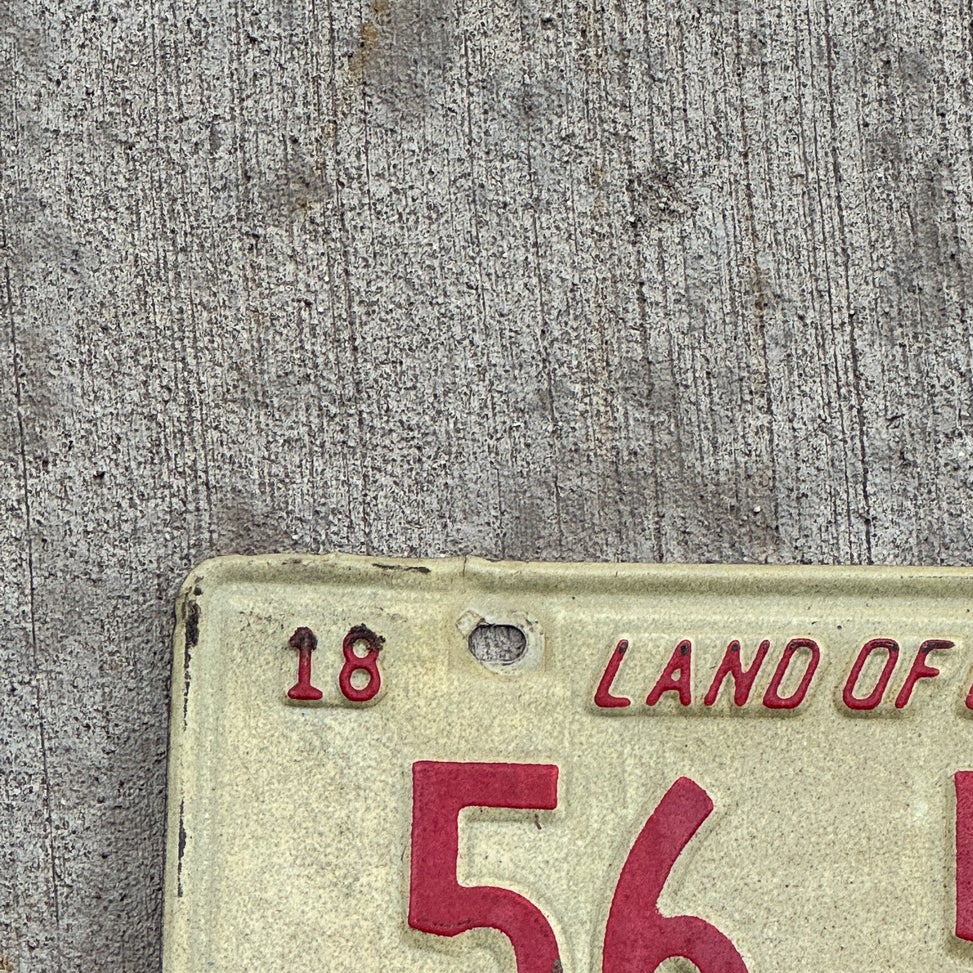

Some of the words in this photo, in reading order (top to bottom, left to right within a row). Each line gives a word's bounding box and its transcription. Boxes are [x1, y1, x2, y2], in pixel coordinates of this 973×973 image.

[287, 627, 386, 702] 18
[594, 638, 821, 711] LAND
[842, 638, 956, 711] OF
